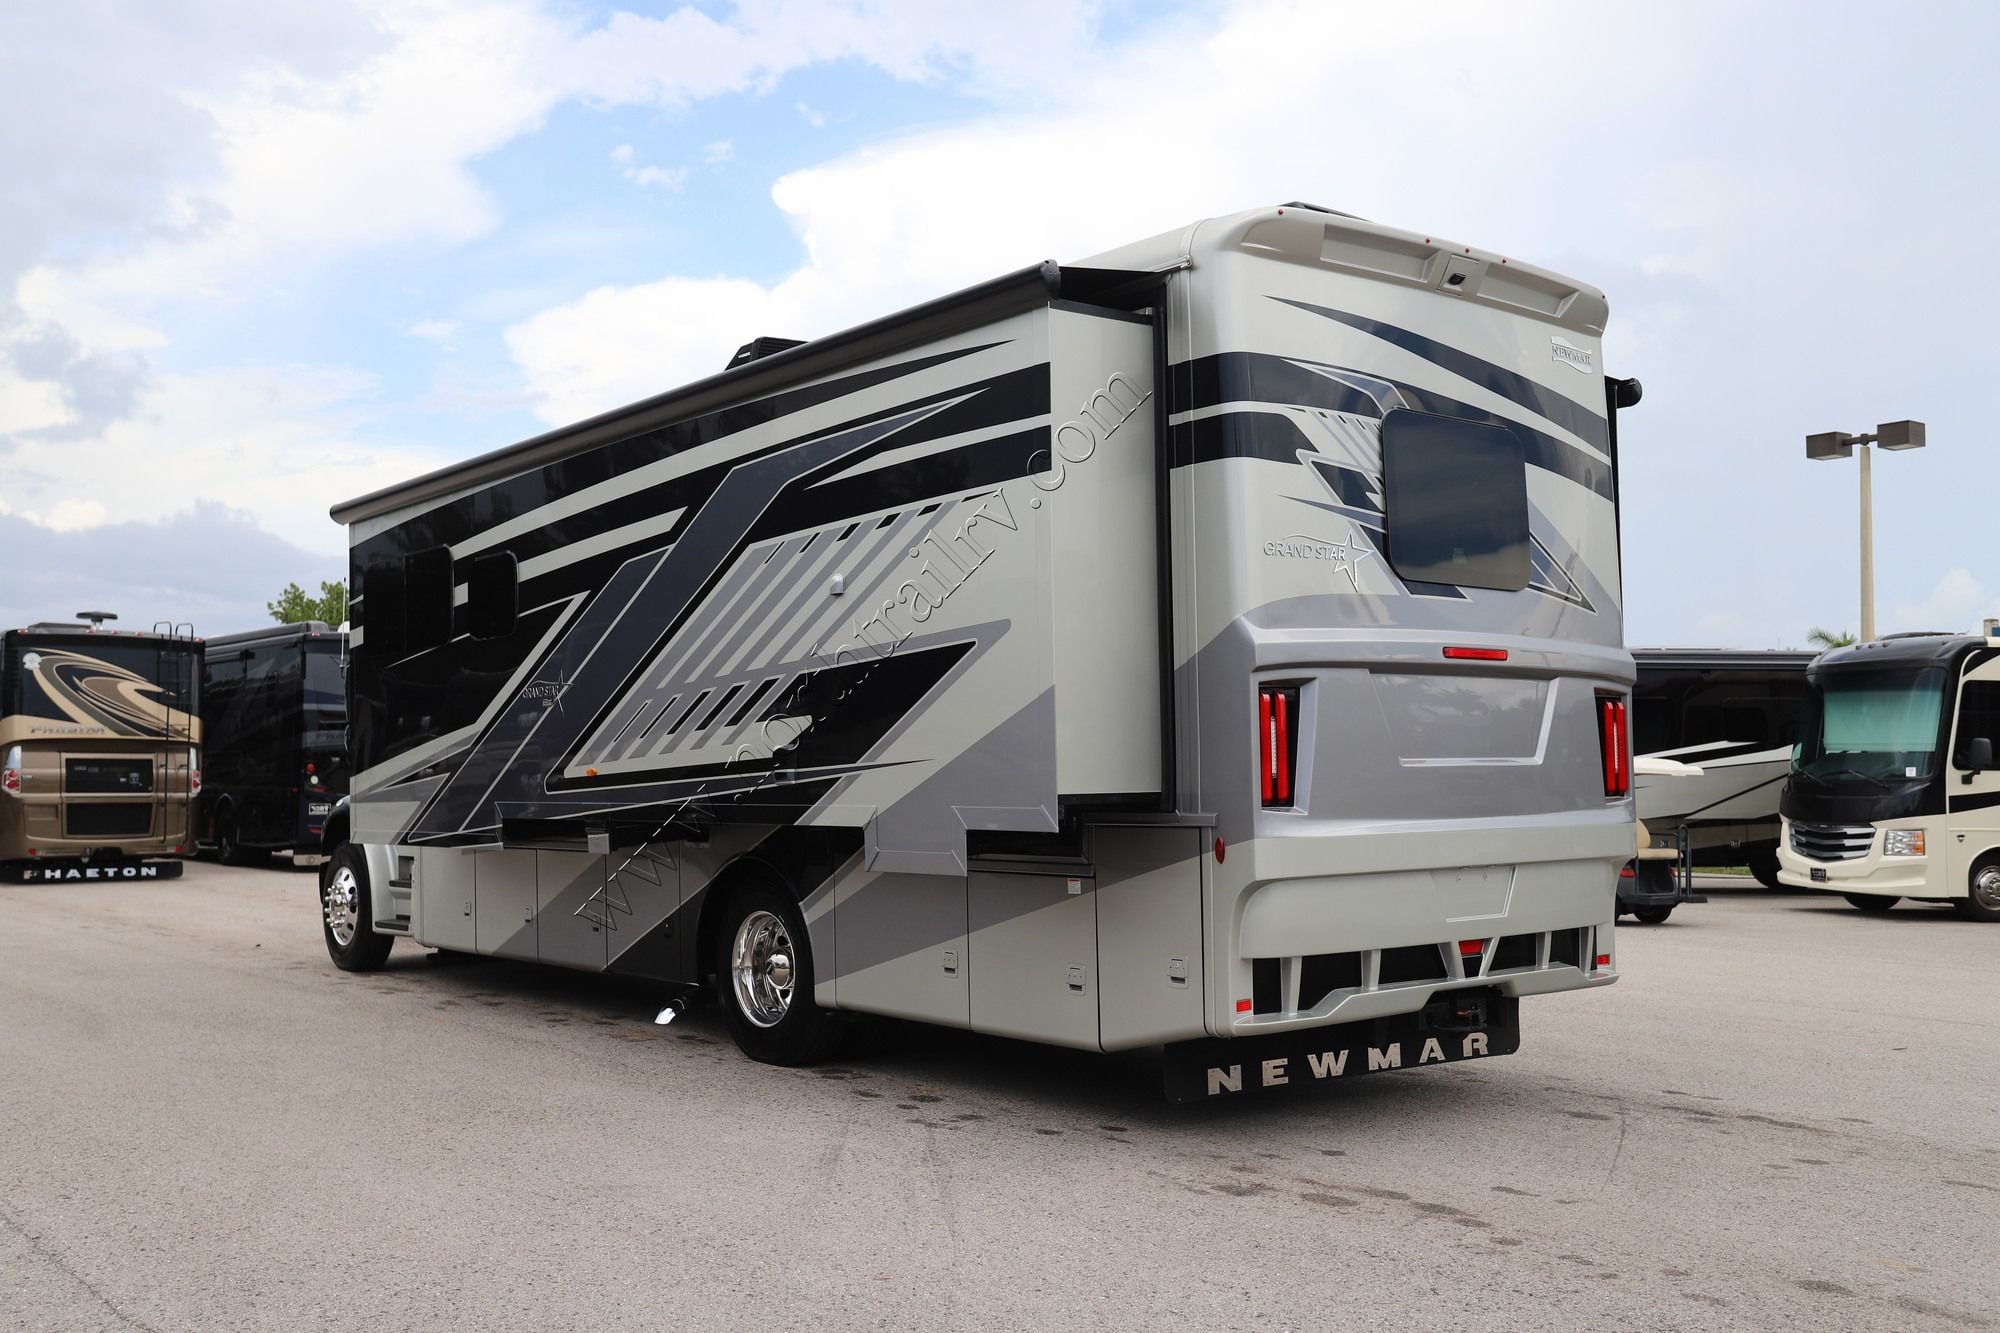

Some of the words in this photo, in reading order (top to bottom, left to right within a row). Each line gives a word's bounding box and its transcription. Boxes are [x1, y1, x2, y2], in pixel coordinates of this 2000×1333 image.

[1551, 344, 1592, 366] NEWMAR
[1263, 540, 1313, 558] GRAND
[1314, 545, 1346, 562] STAR
[23, 867, 157, 879] PHAETON
[1207, 1032, 1489, 1096] NEWMAR
